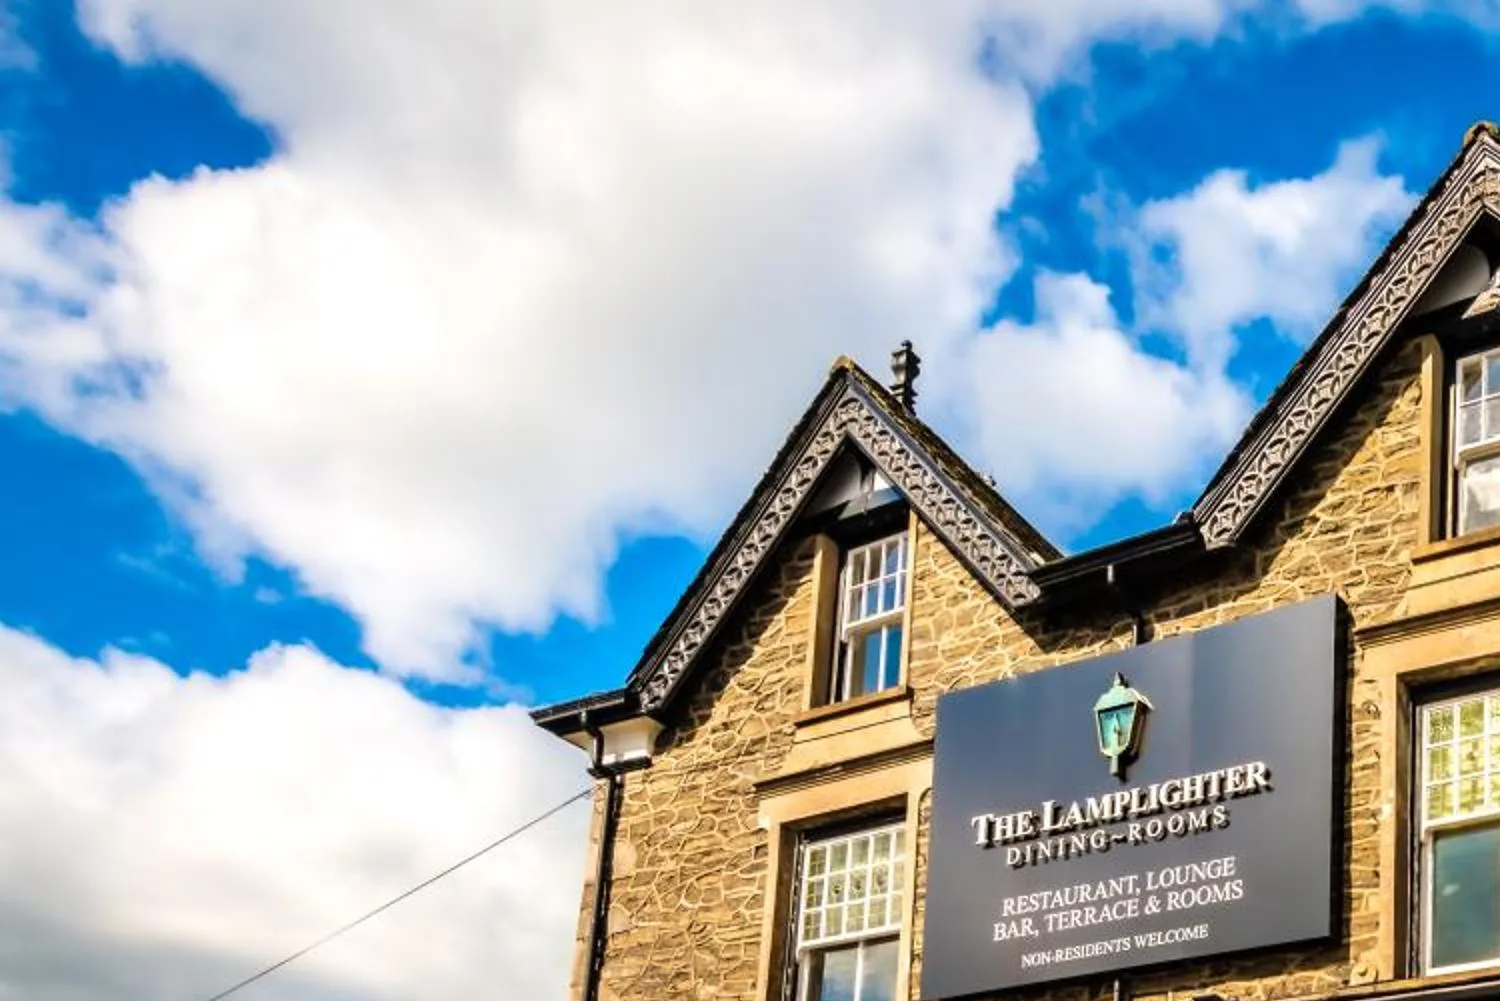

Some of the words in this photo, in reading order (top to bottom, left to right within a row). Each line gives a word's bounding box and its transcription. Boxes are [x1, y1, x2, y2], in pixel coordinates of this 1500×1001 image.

[971, 810, 1033, 845] THE
[1041, 761, 1268, 831] LAMPLIGHTER
[993, 918, 1040, 942] BAR,
[1044, 899, 1139, 933] TERRACE
[1144, 895, 1162, 915] &
[1167, 879, 1244, 911] ROOMS
[1002, 875, 1141, 917] RESTAURANT,
[1146, 856, 1236, 890] LOUNGE
[1021, 937, 1132, 968] NON-RESIDENTS
[1134, 924, 1209, 948] WELCOME
